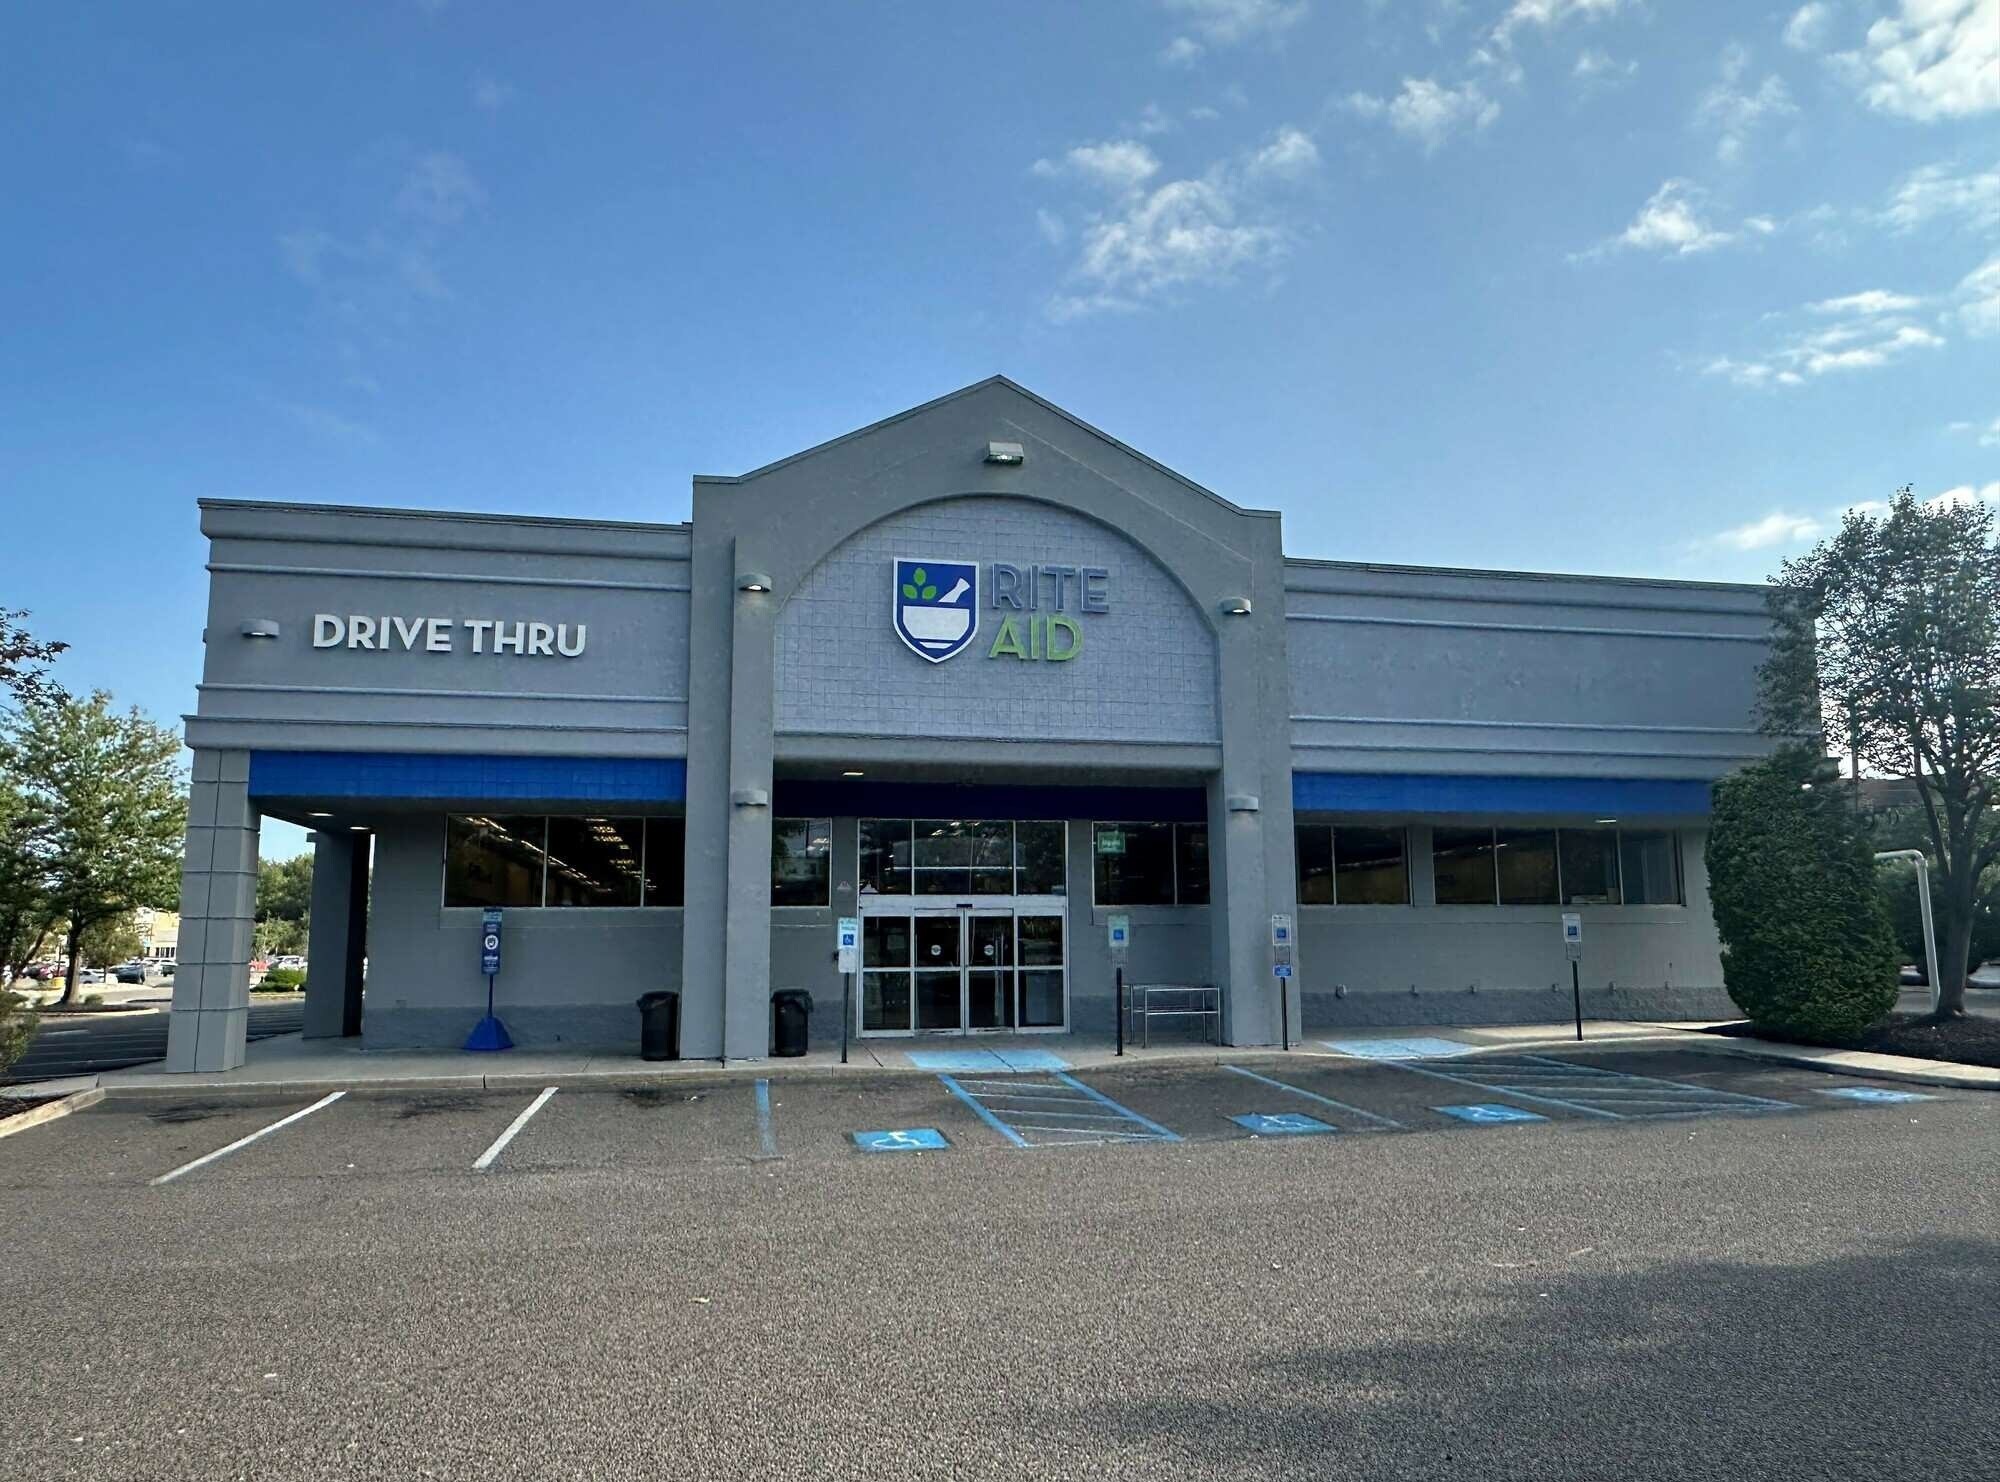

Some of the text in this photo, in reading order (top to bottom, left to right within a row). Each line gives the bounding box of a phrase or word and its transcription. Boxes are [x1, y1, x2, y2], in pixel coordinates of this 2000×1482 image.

[992, 563, 1109, 613] RITE
[313, 614, 586, 657] DRIVE THRU
[988, 614, 1083, 661] AID
